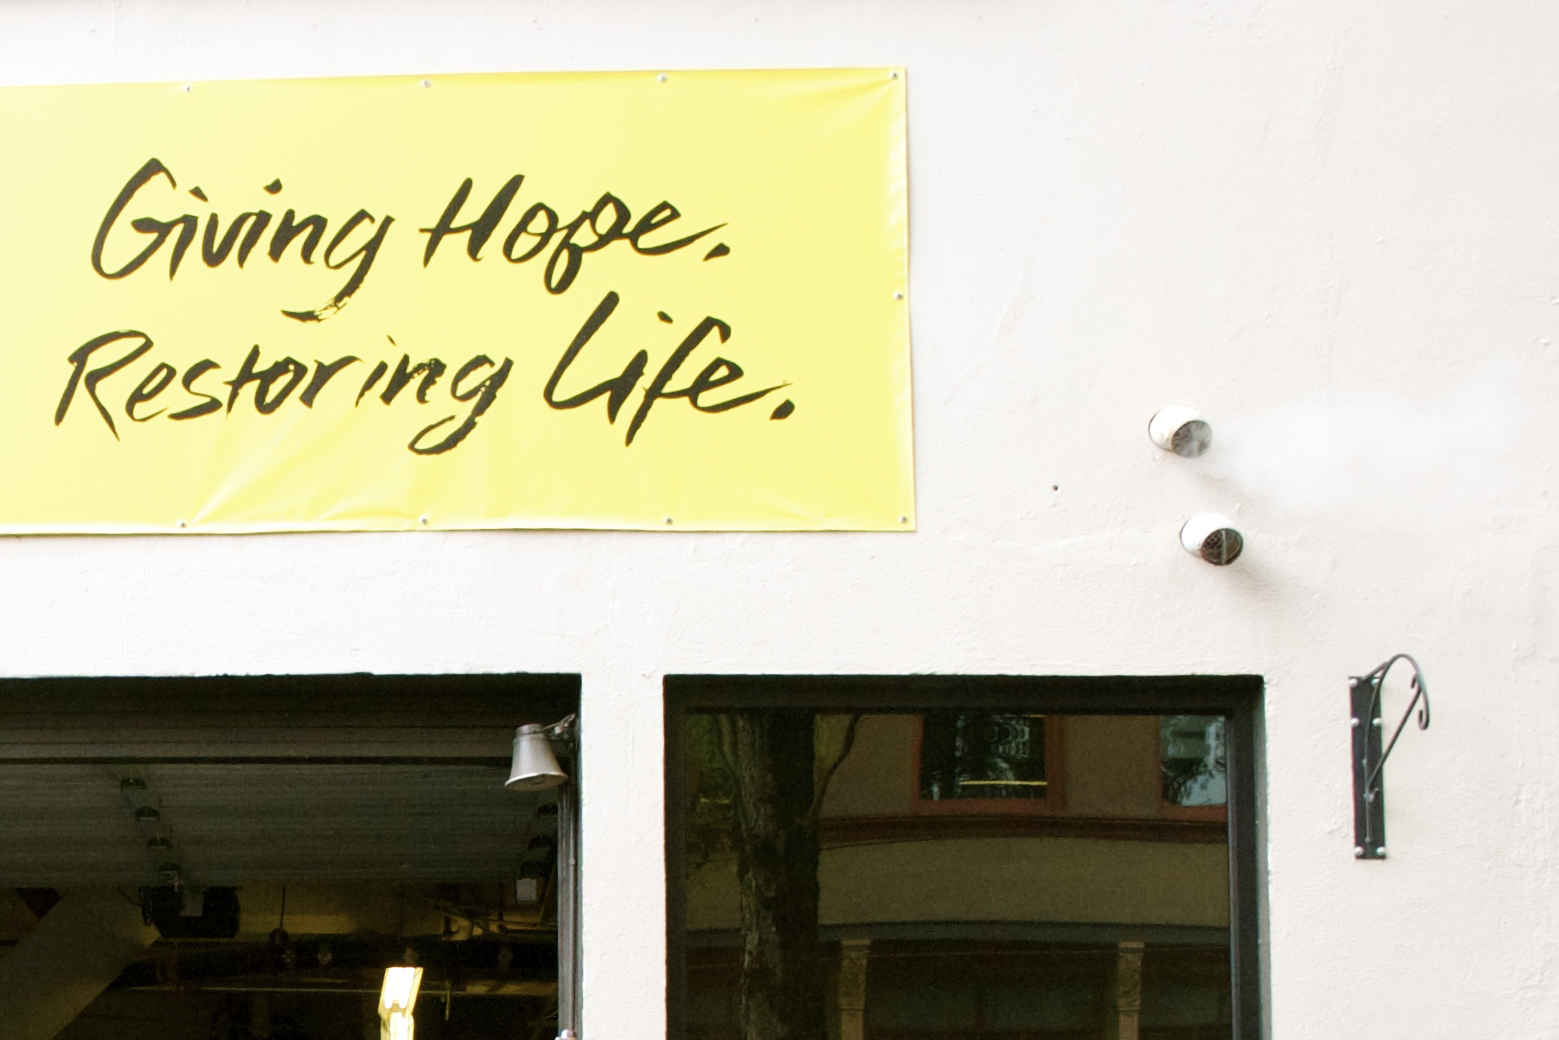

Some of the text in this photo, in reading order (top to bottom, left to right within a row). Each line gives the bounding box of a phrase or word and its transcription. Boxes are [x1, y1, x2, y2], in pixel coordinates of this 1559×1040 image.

[92, 157, 731, 322] Giving Hope.
[54, 290, 795, 455] Restoring Life.
